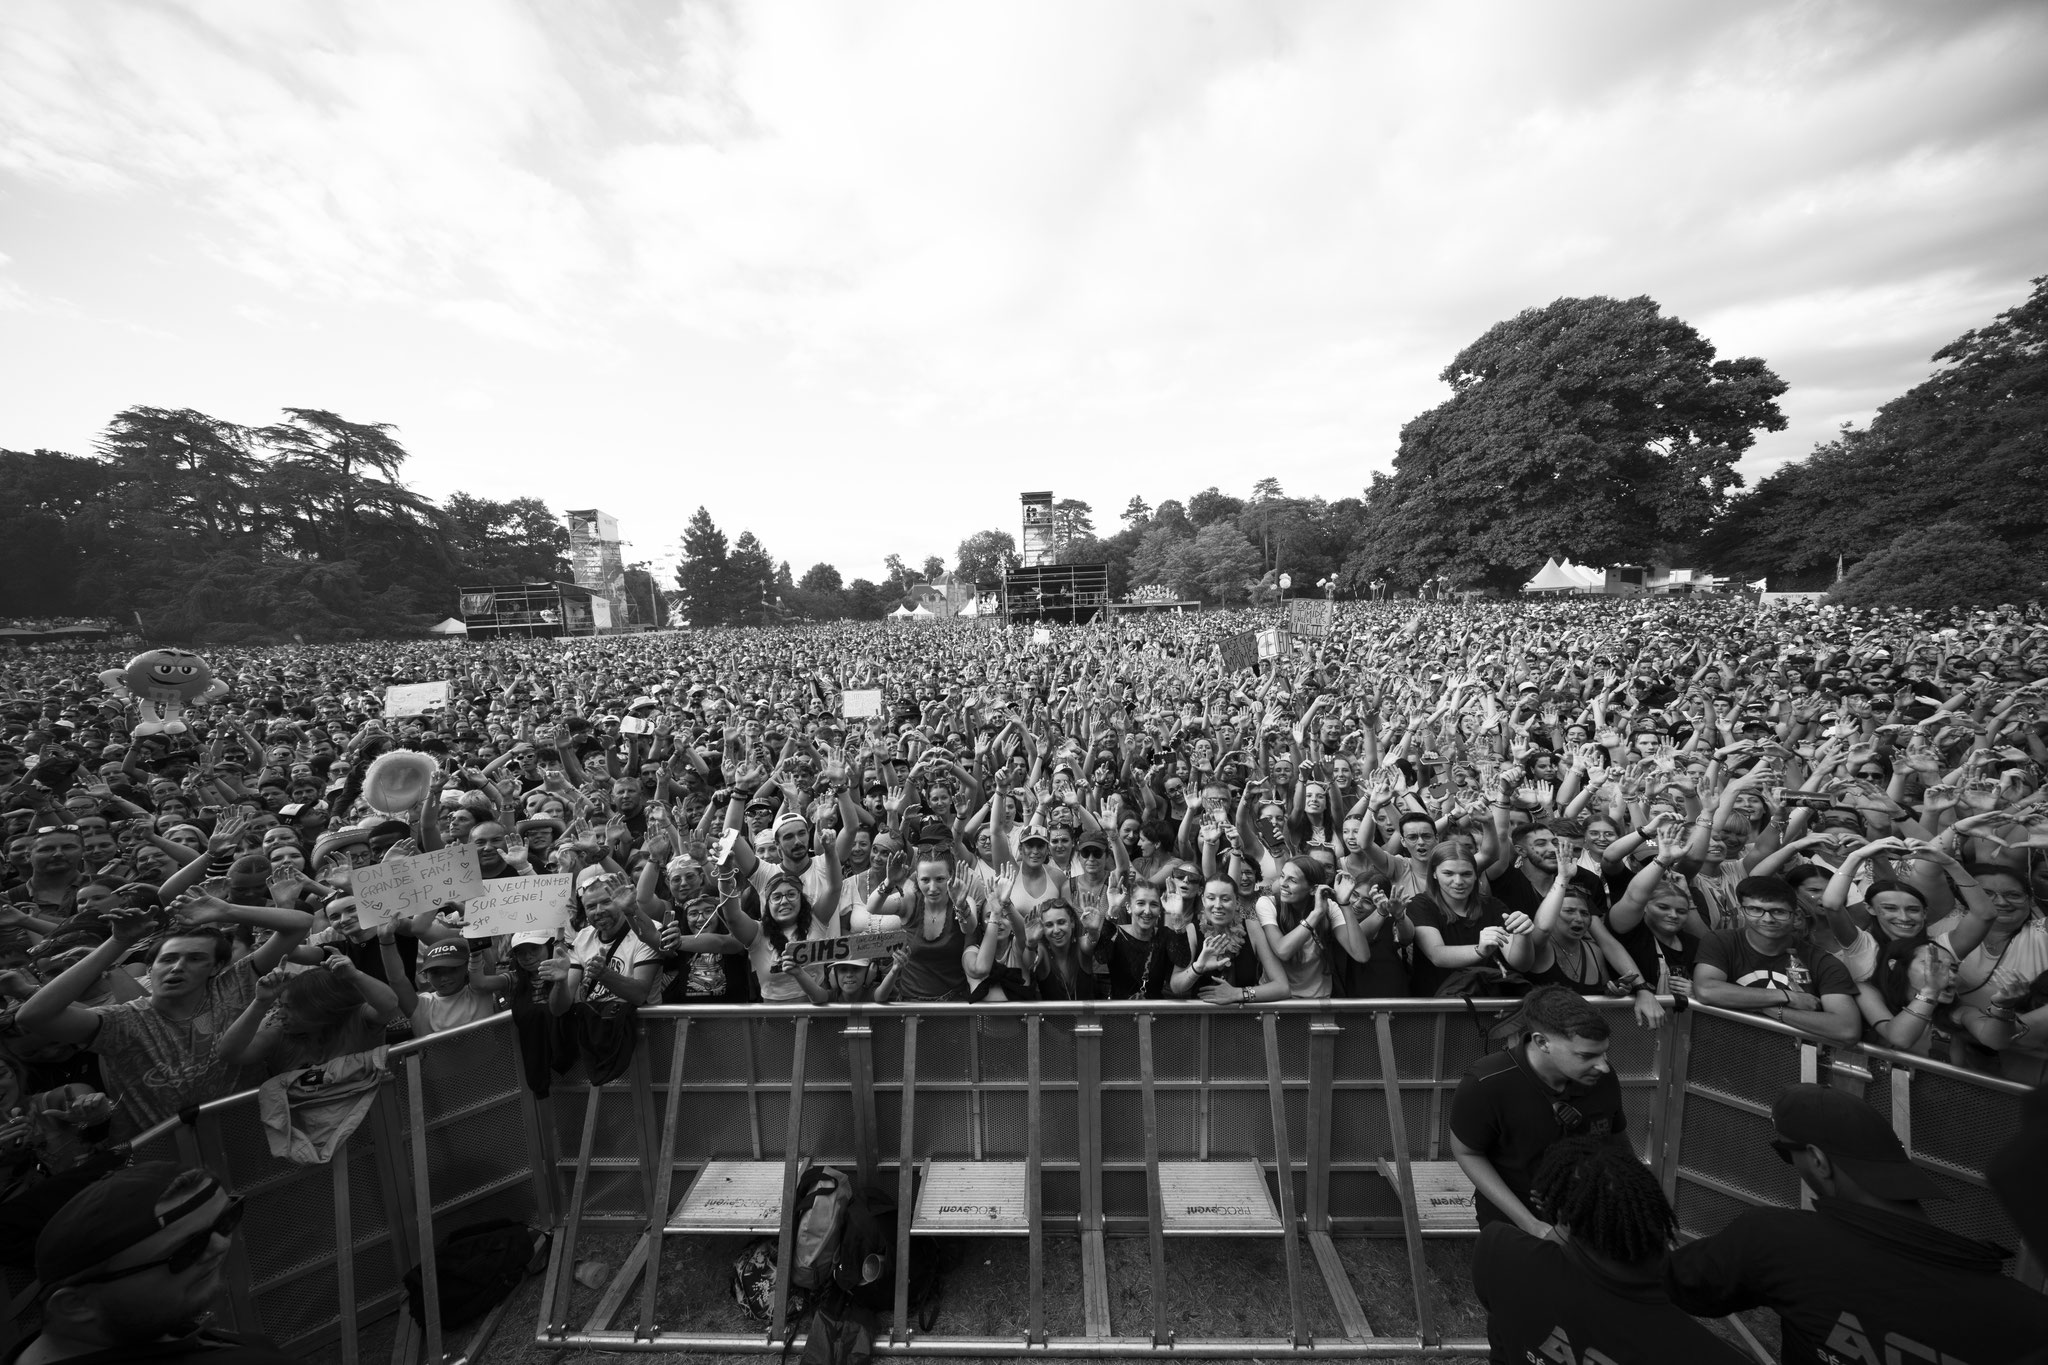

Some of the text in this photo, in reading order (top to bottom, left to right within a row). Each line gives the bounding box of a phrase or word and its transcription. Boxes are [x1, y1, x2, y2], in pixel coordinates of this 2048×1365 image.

[357, 867, 383, 883] ON
[360, 861, 451, 899] GRANDE FAN!
[471, 898, 497, 914] SUR
[793, 937, 850, 964] GIMS
